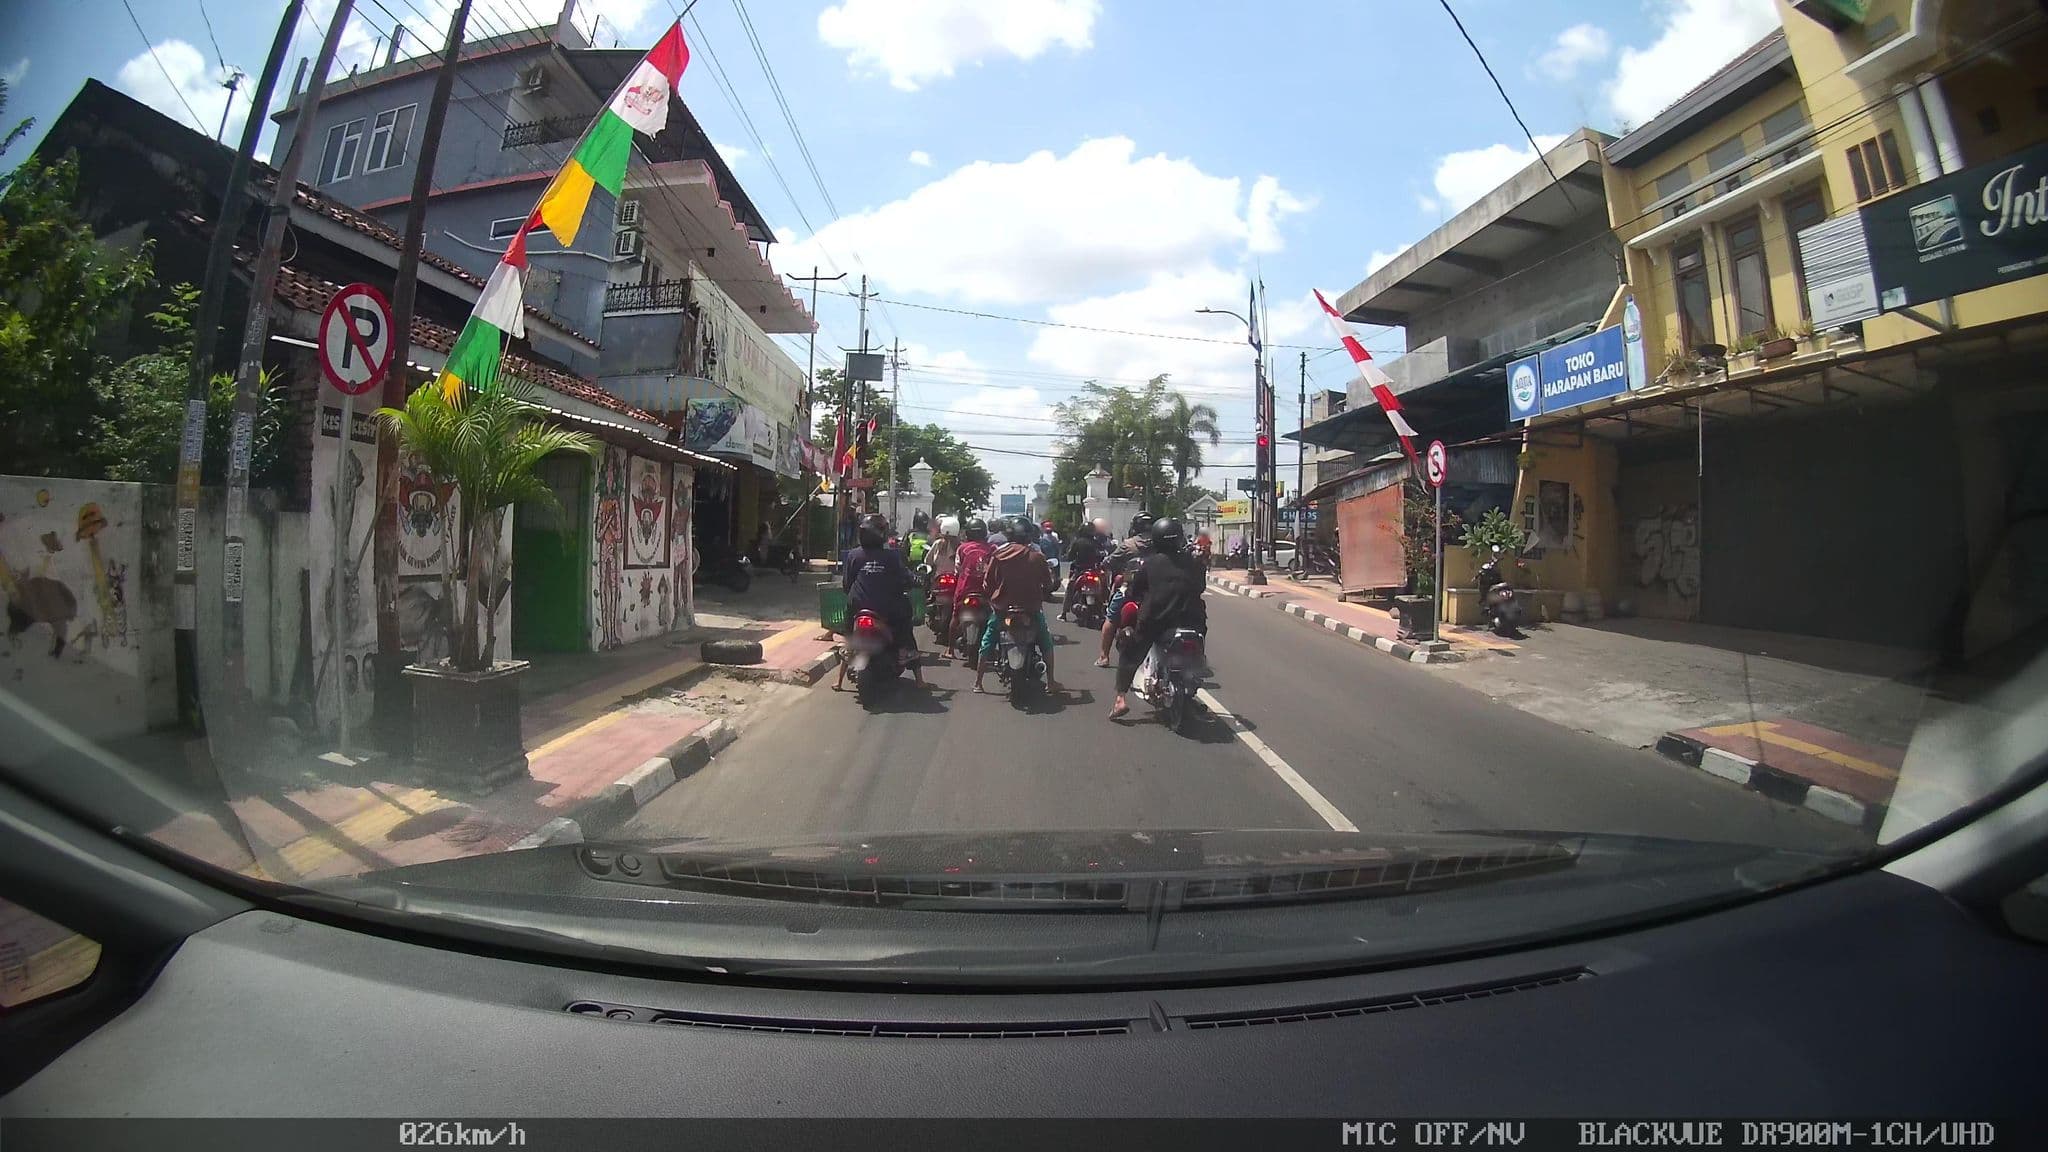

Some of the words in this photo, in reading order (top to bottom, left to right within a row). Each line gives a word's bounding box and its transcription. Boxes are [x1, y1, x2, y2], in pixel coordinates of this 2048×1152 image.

[342, 305, 380, 369] P
[1544, 371, 1592, 397] HARAPAN
[1593, 361, 1624, 384] BARU
[1565, 351, 1595, 373] TOKO
